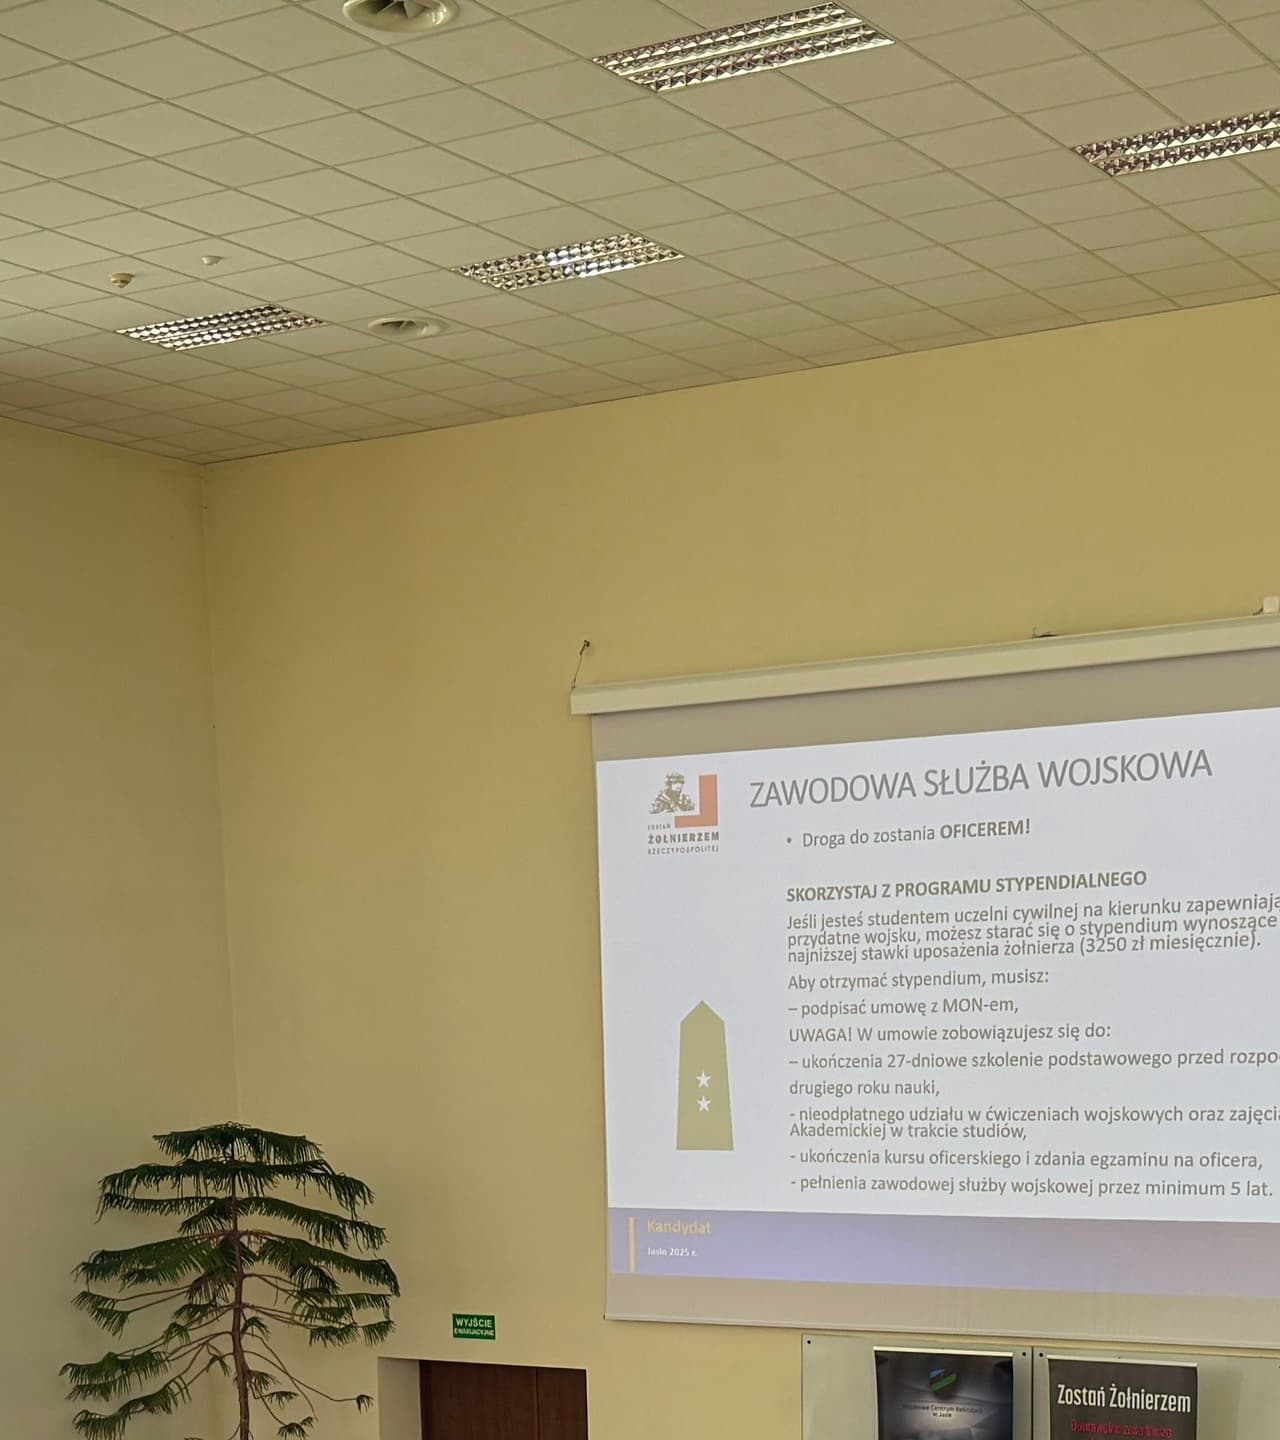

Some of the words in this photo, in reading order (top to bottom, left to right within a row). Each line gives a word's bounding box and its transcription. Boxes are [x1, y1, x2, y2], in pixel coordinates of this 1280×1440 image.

[750, 772, 916, 808] ZAWODOWA
[924, 760, 1029, 796] SŁUŻBA
[1037, 749, 1212, 788] WOJSKOWA
[648, 832, 720, 844] ŻOŁNIERZEM
[803, 833, 845, 849] Droga
[850, 829, 869, 844] do
[874, 826, 934, 843] zostania
[940, 818, 1030, 839] OFICEREM!
[787, 884, 877, 902] SKORZYSTAJ
[881, 884, 891, 898] Z
[896, 879, 991, 897] PROGRAMU
[996, 871, 1147, 892] STYPENDIALNEGO
[787, 913, 816, 929] Jeśli
[820, 911, 863, 931] jesteś
[868, 910, 949, 926] studentem
[955, 906, 1007, 923] uczelni
[1013, 903, 1078, 923] cywilnej
[1084, 905, 1102, 917] na
[1109, 898, 1181, 916] kierunku
[788, 931, 860, 950] przydatne
[865, 928, 921, 946] wojsku,
[926, 927, 982, 943] możesz
[986, 921, 1033, 939] starać
[1038, 922, 1060, 940] się
[1065, 924, 1075, 936] o
[1080, 917, 1177, 937] stypendium
[1183, 916, 1277, 932] wynoszące
[788, 946, 856, 966] najniższej
[861, 944, 908, 960] stawki
[914, 941, 998, 962] uposażenia
[1004, 937, 1074, 956] żołnierza
[1080, 937, 1127, 957] (3250
[1132, 935, 1145, 951] zł
[1150, 930, 1261, 952] miesięcznie).
[788, 975, 815, 992] Aby
[820, 972, 887, 991] otrzymać
[892, 970, 986, 990] stypendium,
[992, 969, 1048, 984] musisz:
[802, 999, 866, 1019] podpisać
[871, 1002, 926, 1016] umowę
[931, 1002, 938, 1013] z
[943, 998, 1018, 1014] MON-em,
[790, 1027, 851, 1042] UWAGA!
[857, 1027, 872, 1041] W
[878, 1026, 937, 1041] umowie
[942, 1024, 1053, 1043] zobowiązujesz
[1058, 1024, 1079, 1041] się
[1085, 1022, 1110, 1037] do:
[803, 1053, 882, 1069] ukończenia
[888, 1053, 967, 1068] 27-dniowe
[972, 1051, 1043, 1067] szkolenie
[1049, 1051, 1172, 1070] podstawowego
[1178, 1048, 1223, 1068] przed
[790, 1080, 853, 1098] drugiego
[858, 1080, 889, 1095] roku
[895, 1080, 939, 1096] nauki,
[800, 1106, 904, 1125] nieodpłatnego
[910, 1106, 963, 1121] udziału
[968, 1110, 981, 1121] w
[986, 1106, 1079, 1121] ćwiczeniach
[1084, 1106, 1183, 1125] wojskowych
[1189, 1110, 1224, 1121] oraz
[790, 1122, 886, 1141] Akademickiej
[890, 1126, 903, 1137] w
[908, 1123, 958, 1137] trakcie
[963, 1123, 1026, 1141] studiów,
[800, 1148, 879, 1163] ukończenia
[885, 1149, 924, 1164] kursu
[929, 1150, 1021, 1168] oficerskiego
[1027, 1151, 1029, 1165] i
[1035, 1150, 1085, 1166] zdania
[1091, 1152, 1168, 1170] egzaminu
[1174, 1156, 1193, 1167] na
[1200, 1152, 1262, 1171] oficera,
[801, 1175, 866, 1192] pełnienia
[871, 1176, 954, 1195] zawodowej
[959, 1177, 1006, 1195] służby
[1011, 1178, 1093, 1197] wojskowej
[1099, 1183, 1140, 1197] przez
[1146, 1180, 1225, 1196] minimum
[1231, 1182, 1240, 1195] 5
[1247, 1180, 1272, 1196] lat.
[647, 1219, 712, 1236] Kandydat
[670, 1248, 689, 1257] 2025
[455, 1317, 492, 1328] WYJŚCIE
[1057, 1384, 1105, 1408] Zostań
[1109, 1383, 1192, 1413] Żołnierzem
